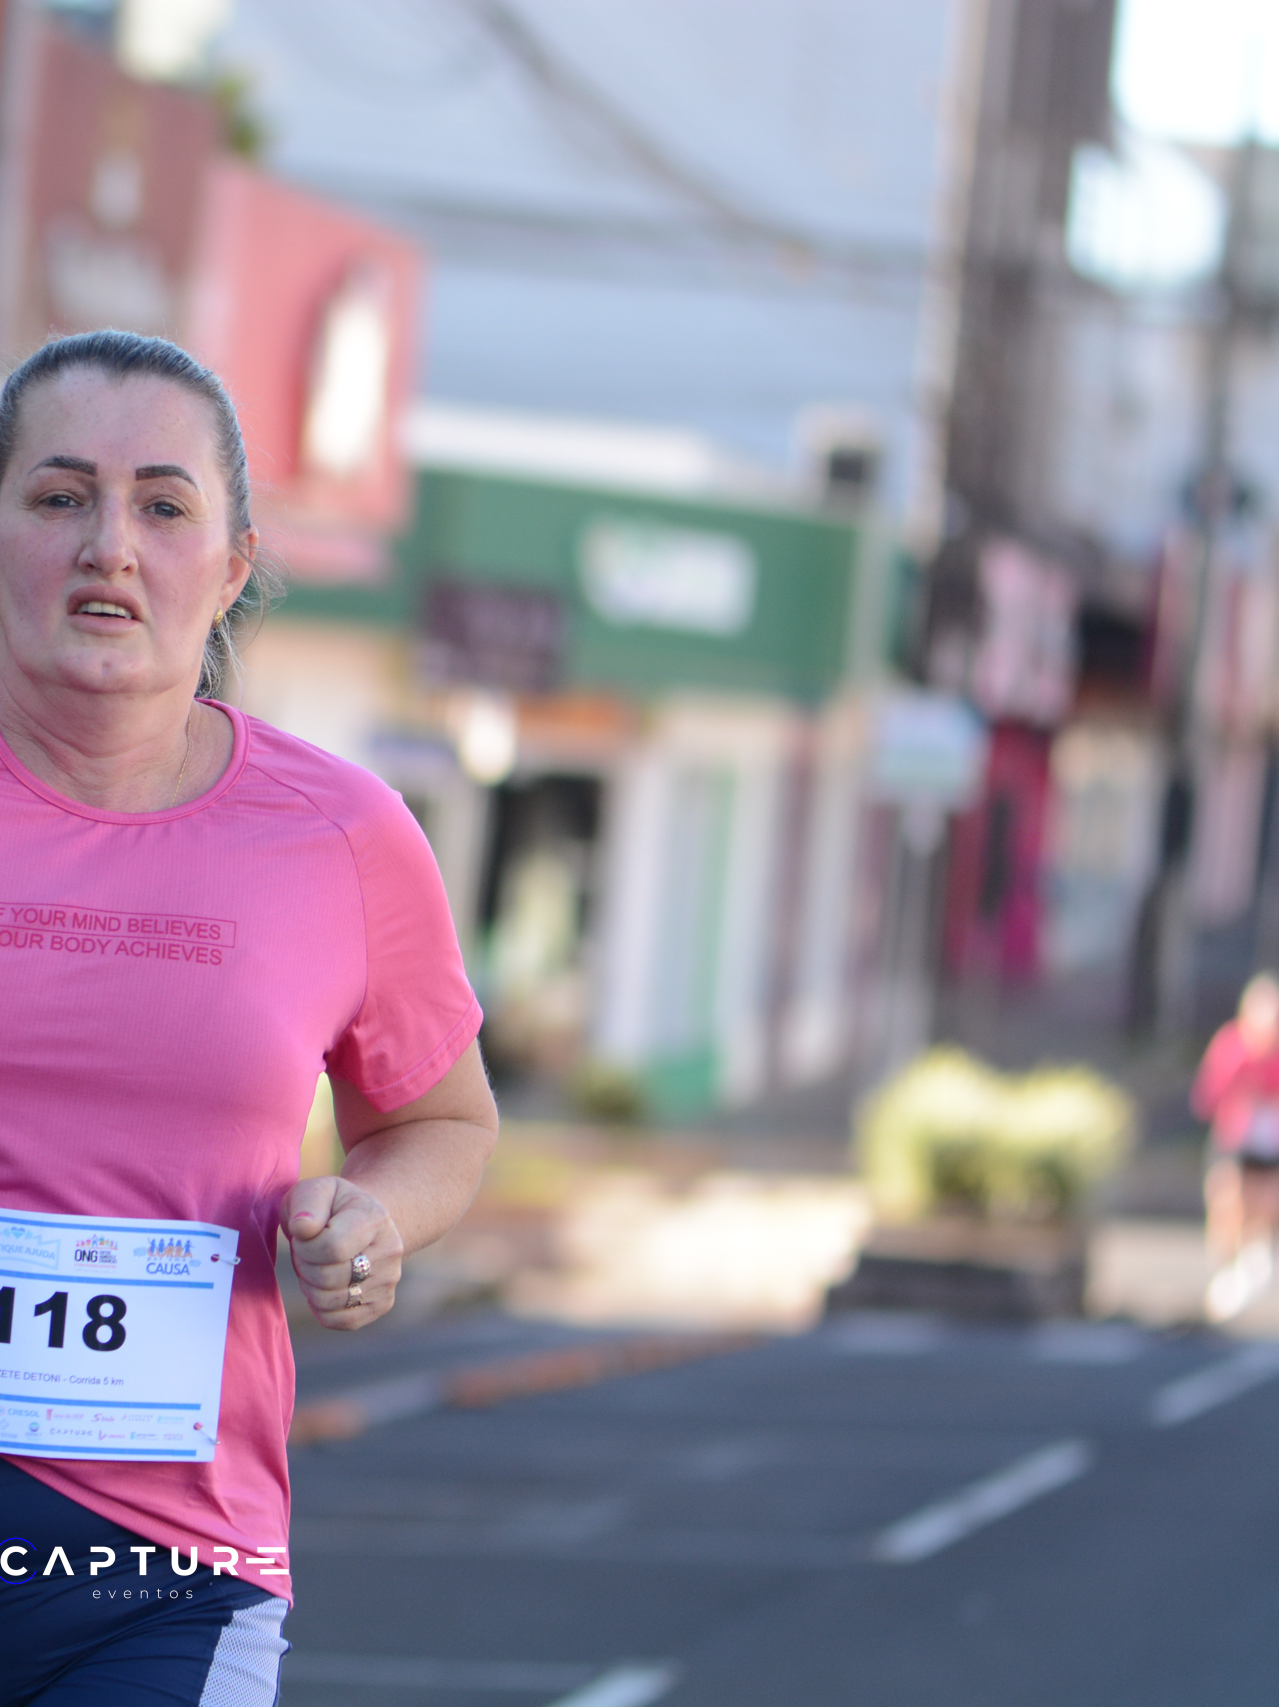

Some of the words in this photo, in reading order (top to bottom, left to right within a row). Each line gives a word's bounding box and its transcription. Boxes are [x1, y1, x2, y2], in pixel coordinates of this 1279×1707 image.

[10, 907, 67, 928] YOUR
[72, 912, 121, 933] MIND
[127, 917, 221, 941] BELIEVES
[50, 934, 112, 955] BODY
[114, 940, 223, 966] ACHIEVES
[25, 1246, 56, 1260] AJUDA
[74, 1249, 99, 1263] ONG
[146, 1262, 190, 1276] CAUSA
[23, 1371, 61, 1383] DETONI
[69, 1375, 101, 1386] Corrida
[103, 1376, 109, 1386] 5
[111, 1377, 124, 1386] km
[7, 1408, 40, 1418] CRESOL
